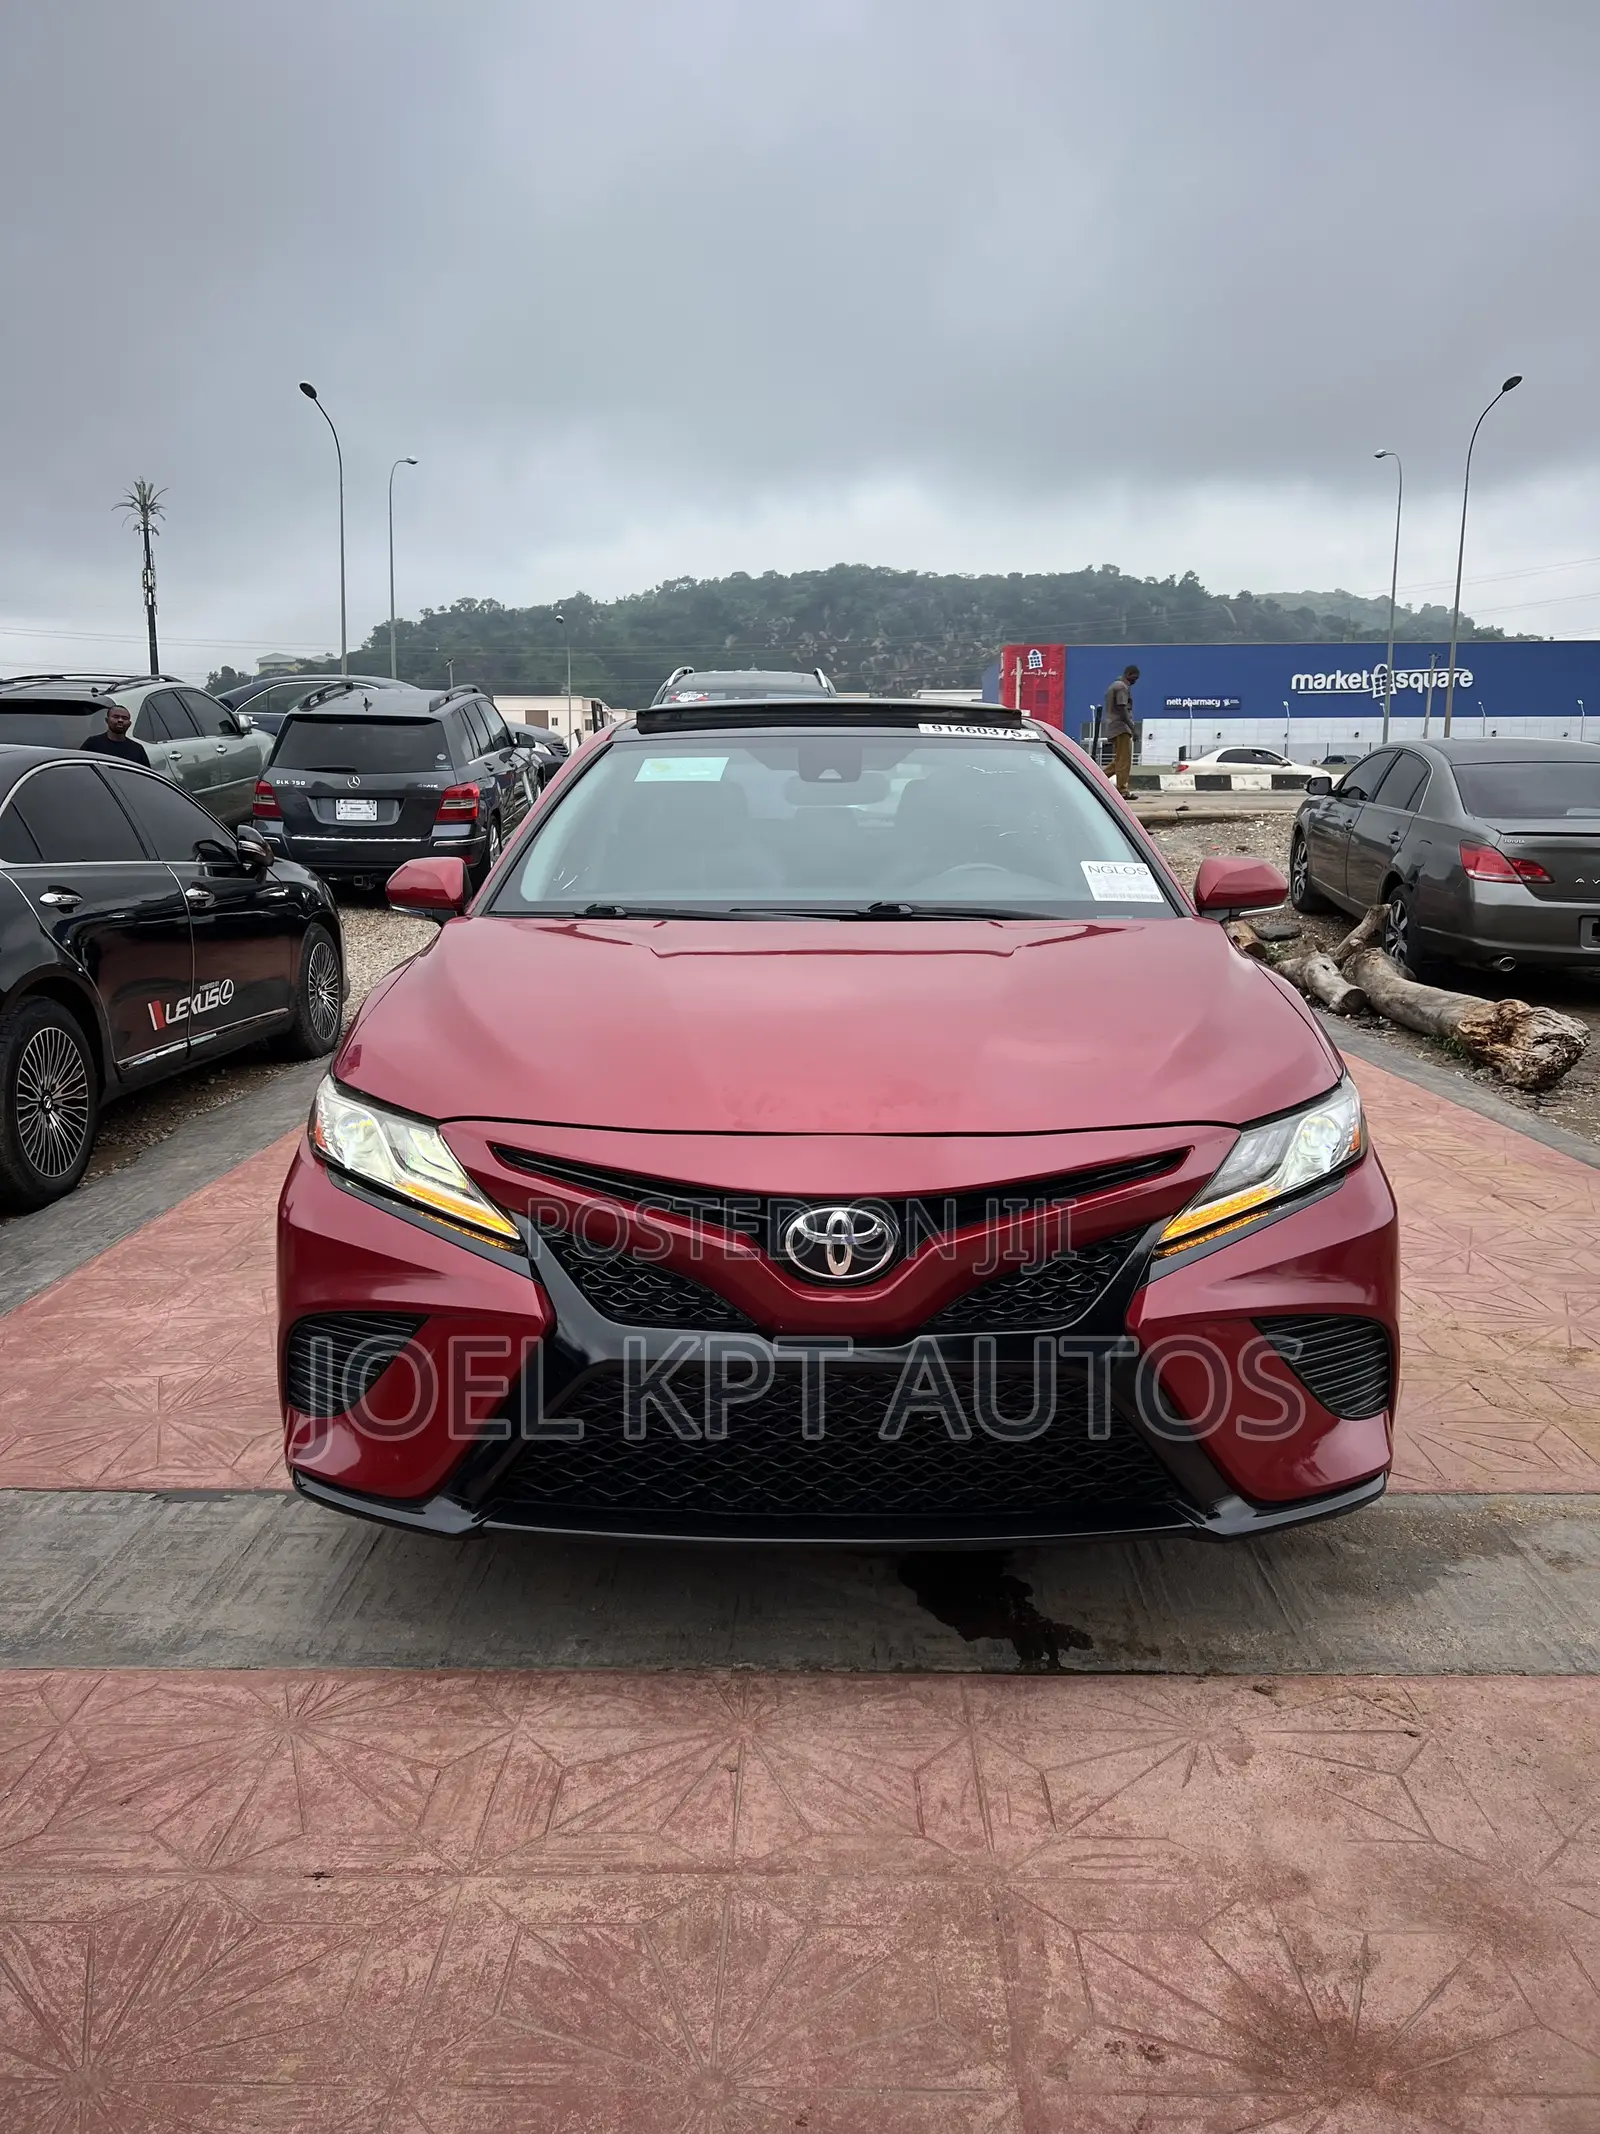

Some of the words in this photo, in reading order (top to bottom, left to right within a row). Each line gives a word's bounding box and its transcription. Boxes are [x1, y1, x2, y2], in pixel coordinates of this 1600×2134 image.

[1291, 670, 1369, 690] market
[1395, 670, 1474, 693] square
[1166, 697, 1181, 706] nett
[1182, 697, 1220, 708] pharmacy
[931, 725, 1022, 738] 91460375
[1087, 865, 1149, 876] NGLOS
[165, 987, 220, 1024] LEXUS
